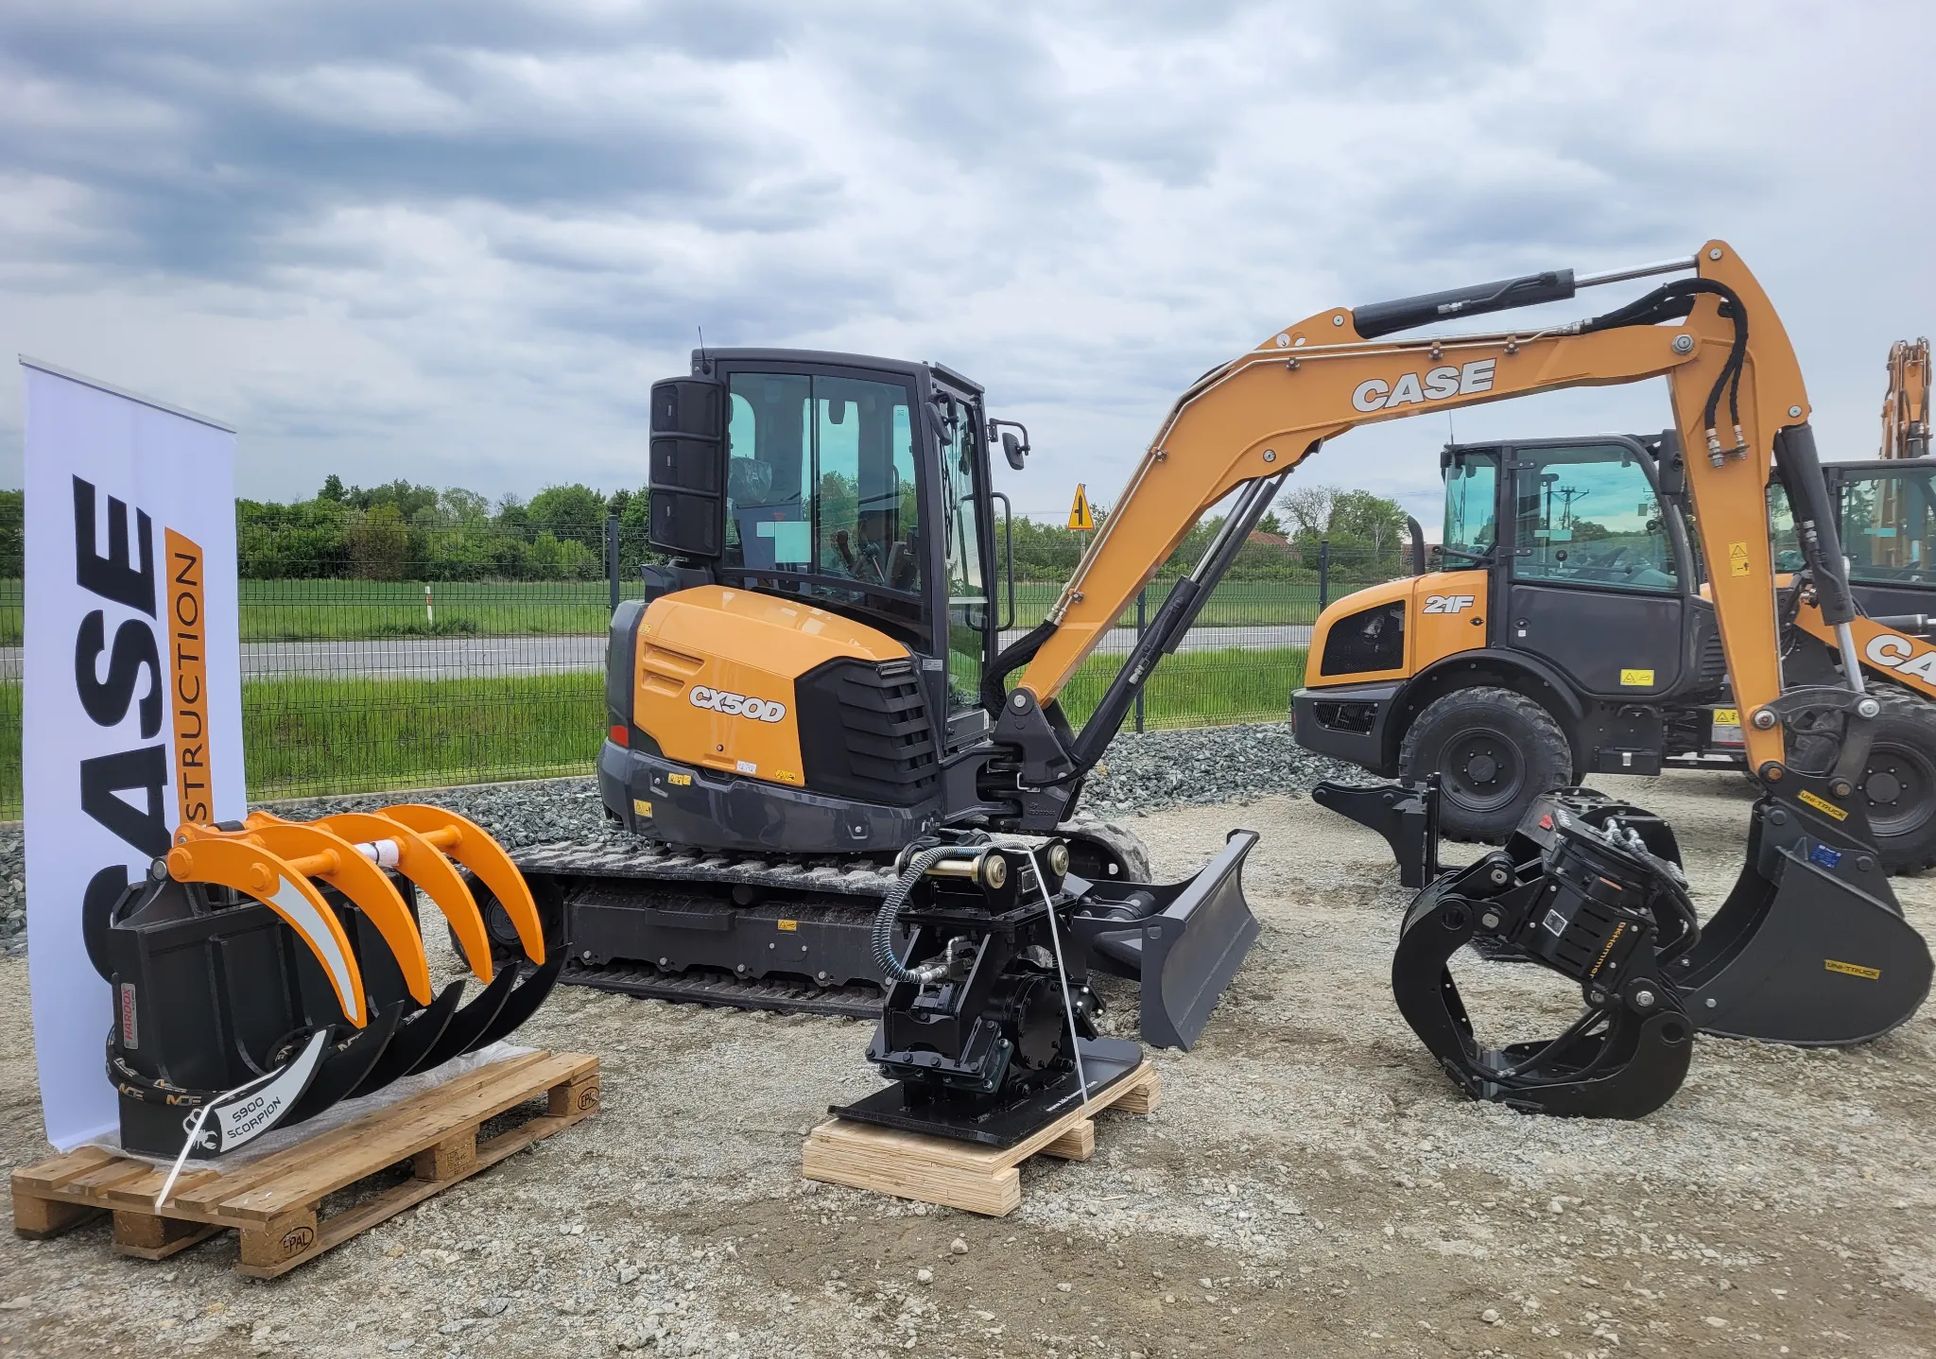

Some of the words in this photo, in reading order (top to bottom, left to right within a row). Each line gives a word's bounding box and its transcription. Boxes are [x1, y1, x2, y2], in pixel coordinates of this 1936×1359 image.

[1352, 357, 1497, 412] CASE
[1423, 594, 1475, 614] 21F
[174, 552, 208, 825] STRUCTION
[689, 684, 787, 723] CX50D
[123, 988, 133, 1041] HARDOX
[227, 1096, 282, 1139] SCORPION
[232, 1096, 265, 1123] S900
[283, 1231, 310, 1253] EPAL
